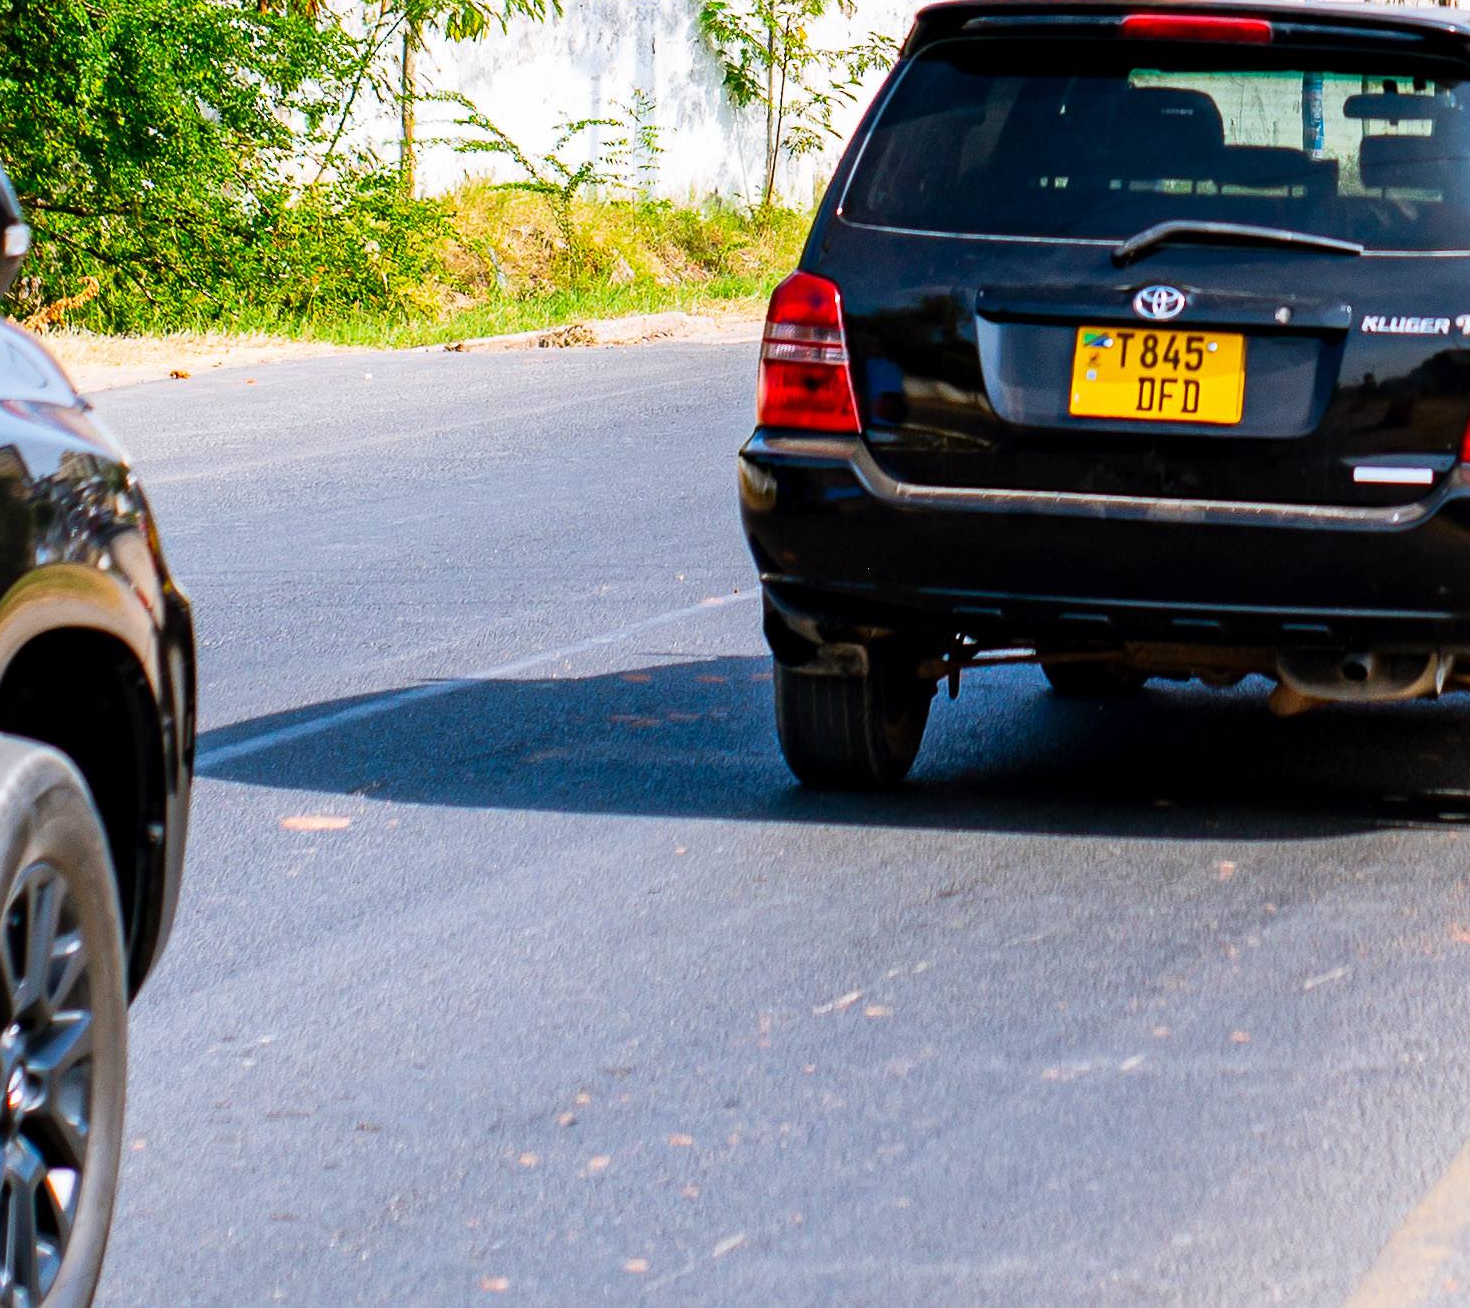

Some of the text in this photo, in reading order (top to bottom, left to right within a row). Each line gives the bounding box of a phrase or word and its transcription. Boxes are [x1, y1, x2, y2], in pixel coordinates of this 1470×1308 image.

[1361, 315, 1451, 335] KLUGER
[1116, 332, 1205, 372] T 845
[1135, 376, 1201, 414] DFD
